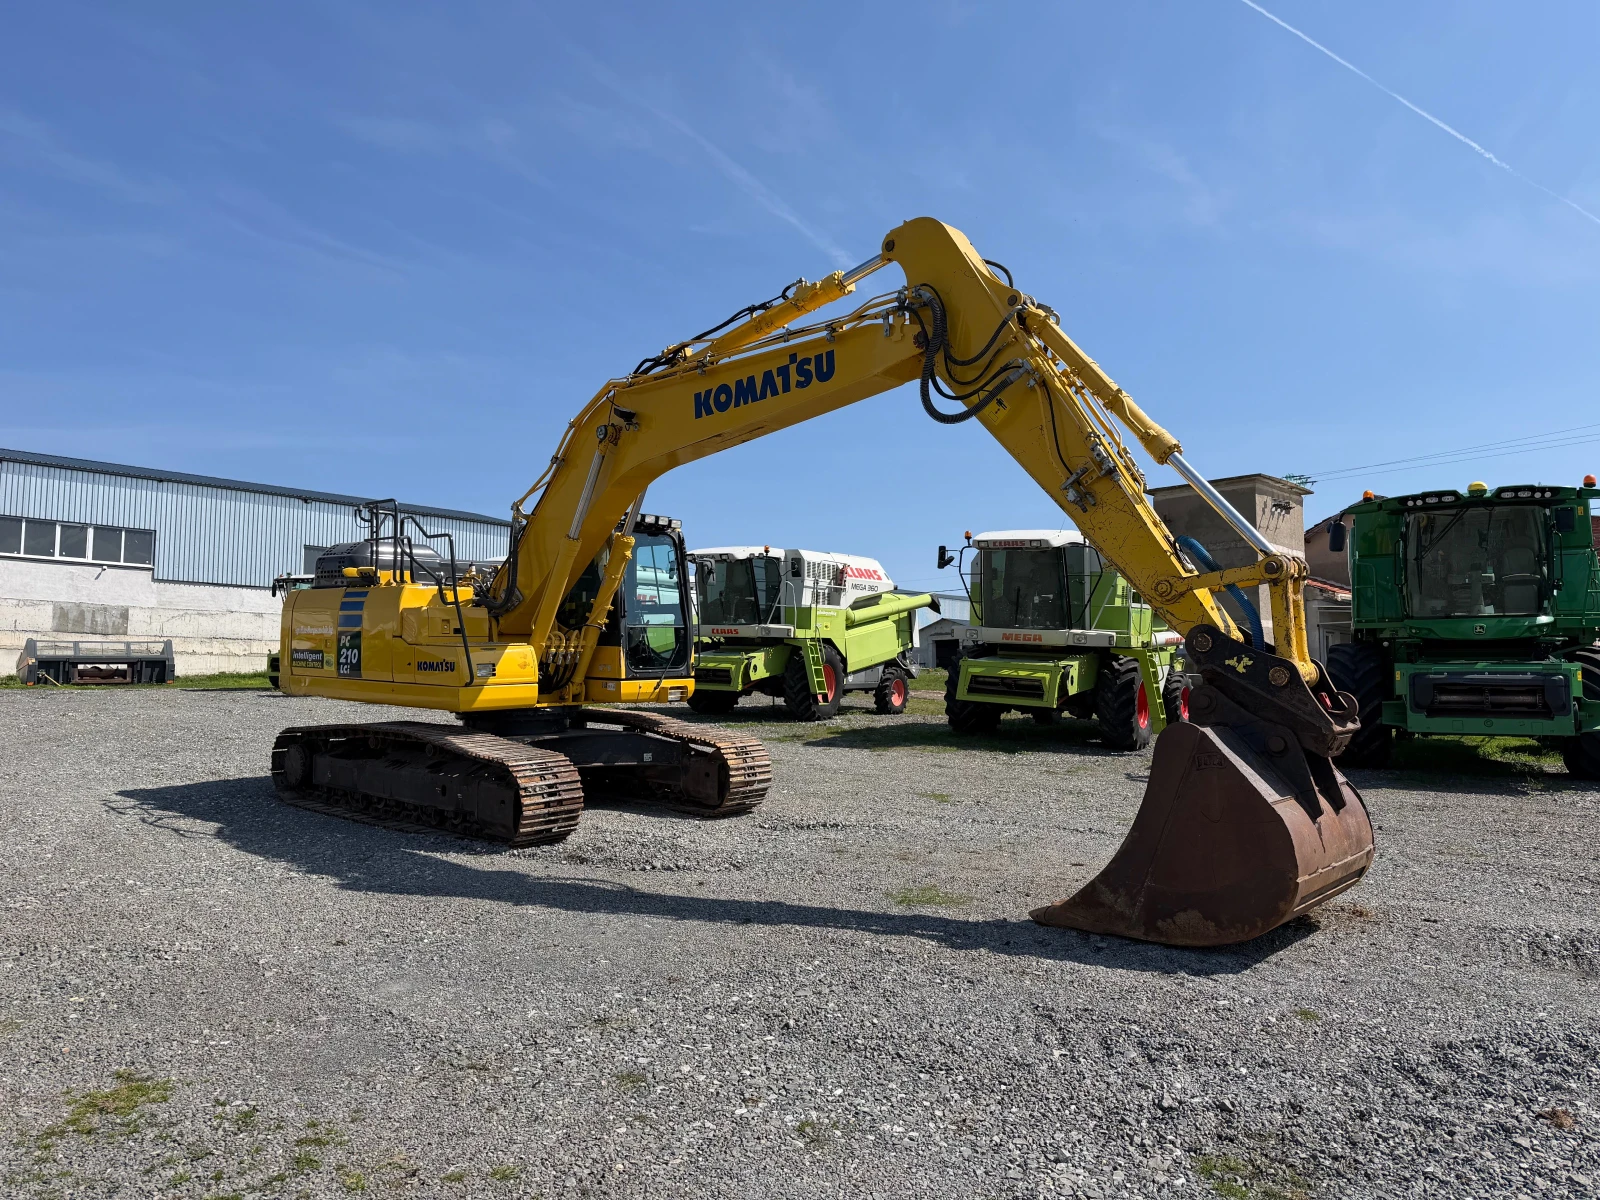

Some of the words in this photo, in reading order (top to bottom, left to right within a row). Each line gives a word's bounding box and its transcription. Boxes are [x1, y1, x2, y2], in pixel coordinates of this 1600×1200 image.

[694, 350, 836, 419] KOMATSU
[851, 583, 867, 591] MEGA
[340, 635, 351, 647] PC
[1001, 632, 1043, 642] MEGA
[292, 651, 323, 661] intelligent
[339, 648, 359, 664] 210
[417, 658, 455, 673] KOMATSU
